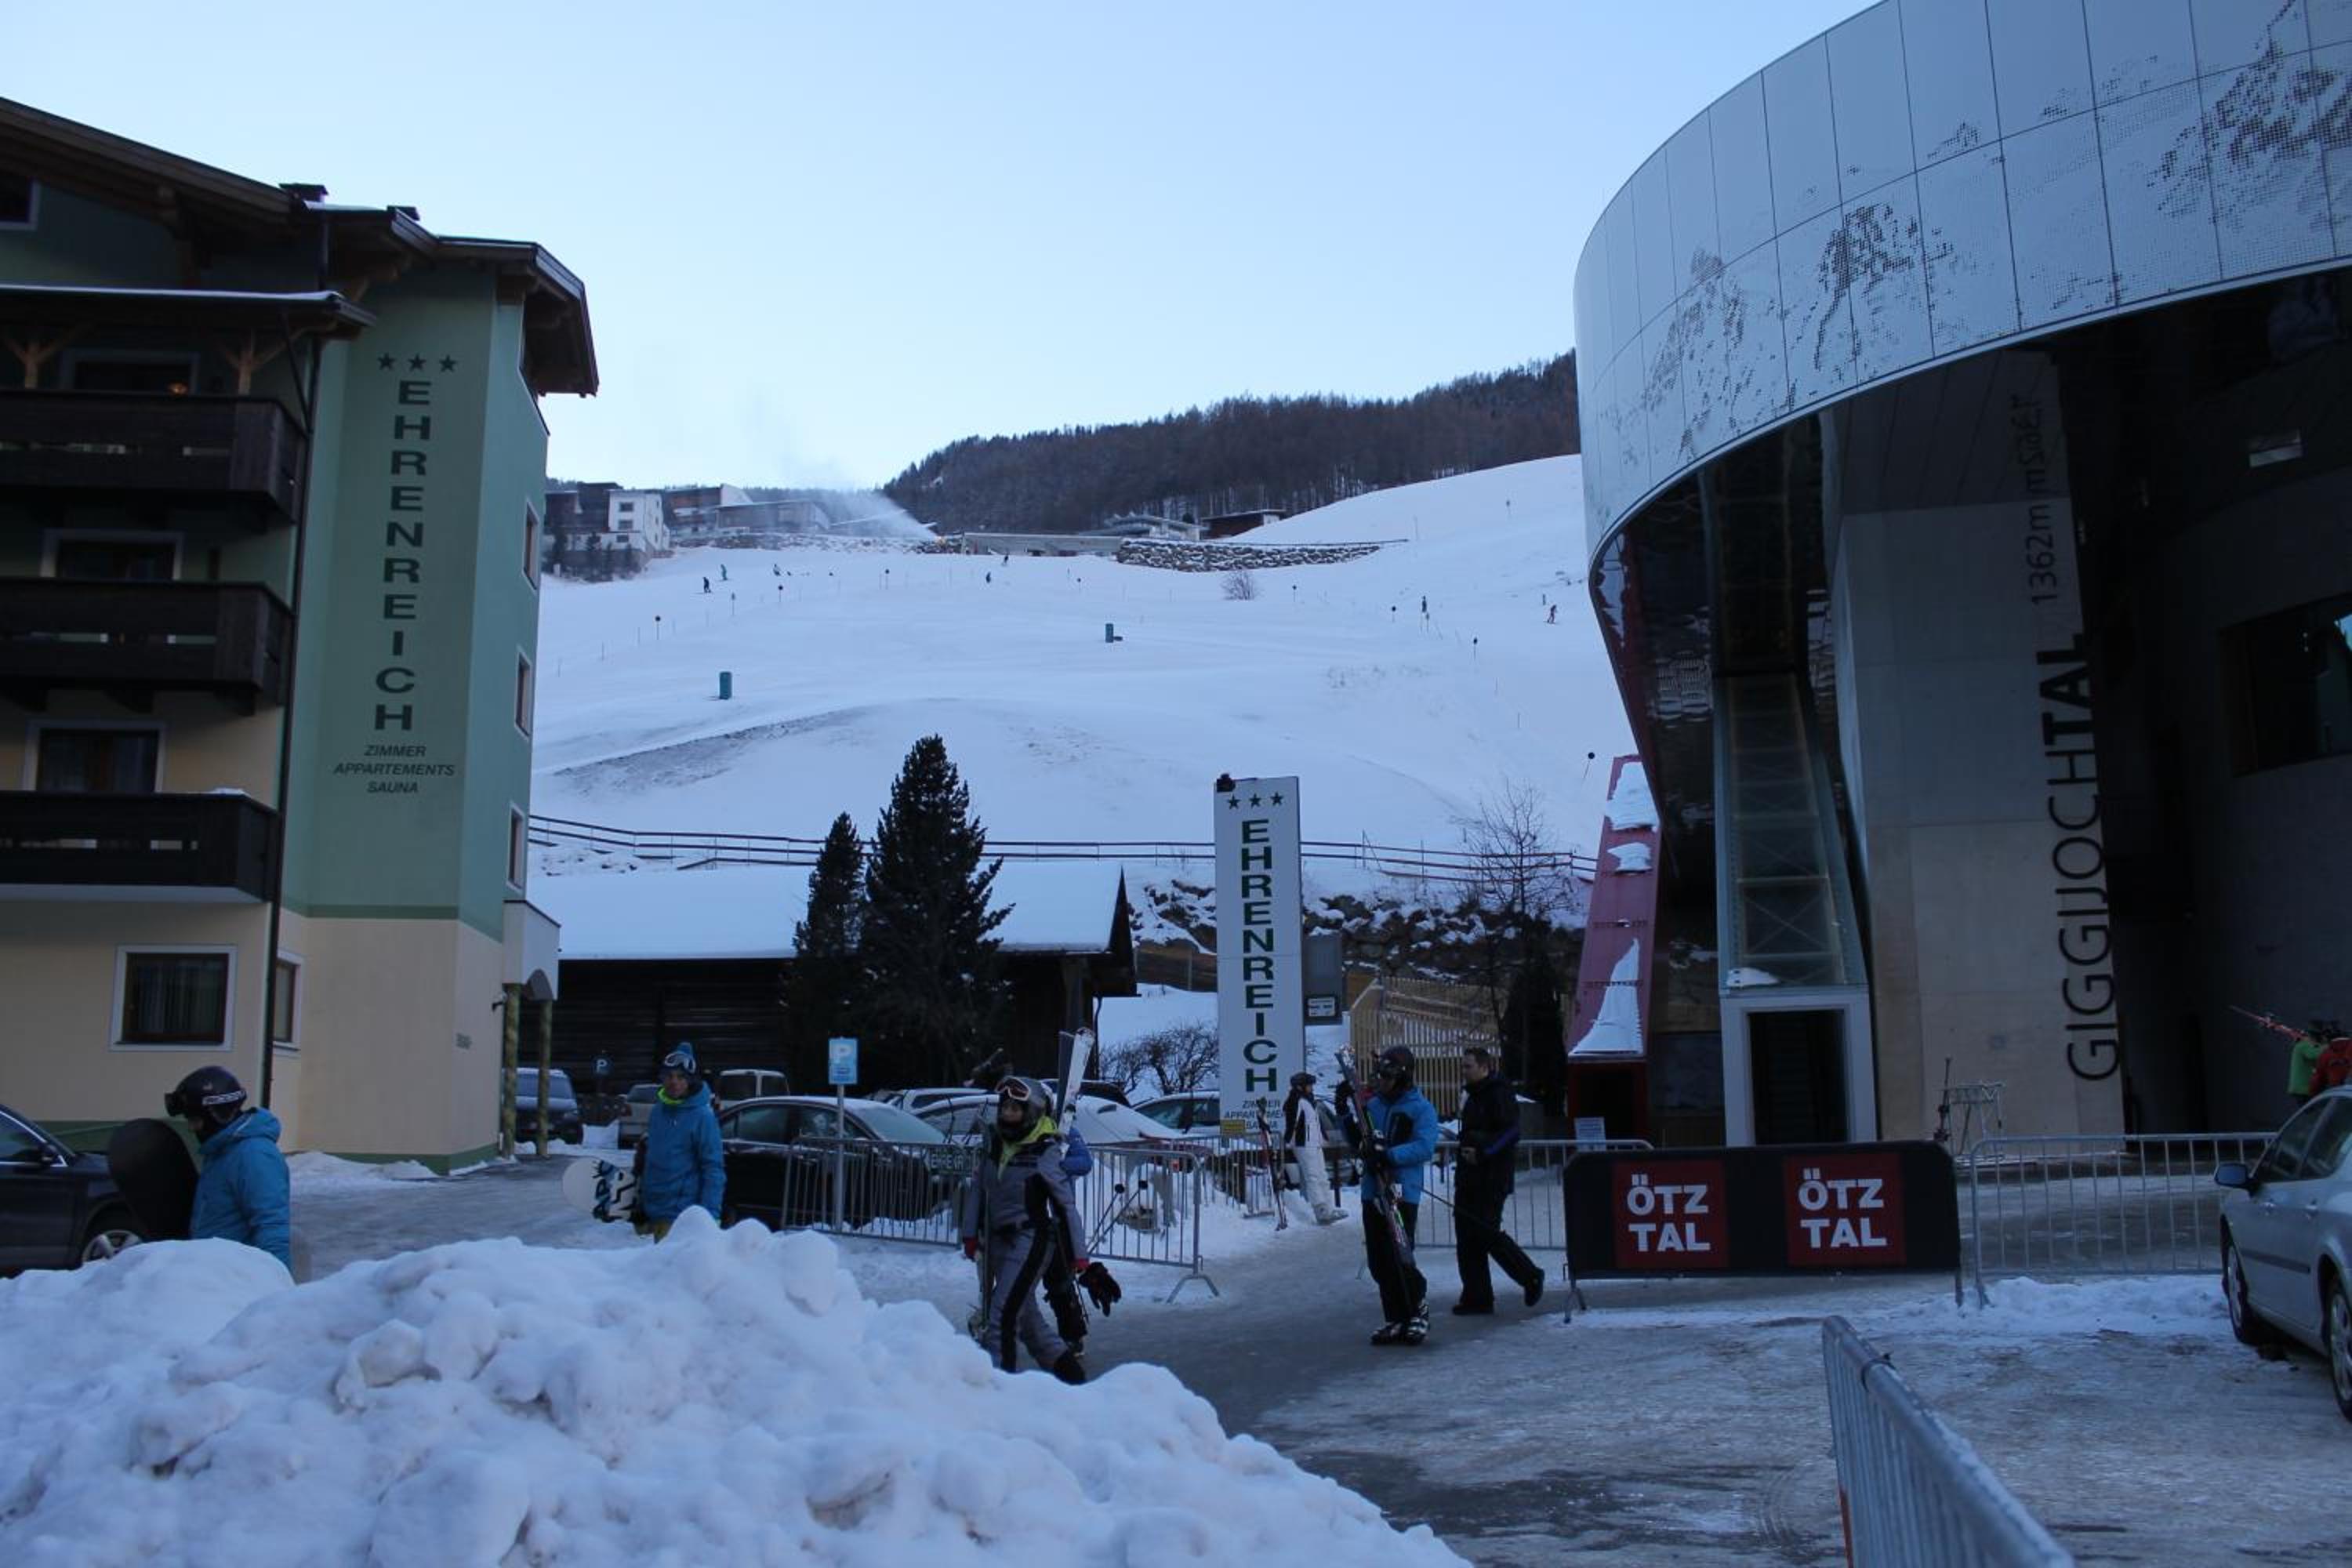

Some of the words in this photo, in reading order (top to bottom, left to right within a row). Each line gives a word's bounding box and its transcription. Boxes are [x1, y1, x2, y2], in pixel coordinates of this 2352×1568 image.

[374, 380, 432, 731] EHRENREICH
[2025, 504, 2057, 604] 1362m
[364, 745, 426, 757] ZIMMER
[333, 763, 456, 776] APPARTEMENTS
[367, 781, 419, 793] SAUNA
[2037, 633, 2119, 1082] GIGGIJOCHTAL
[1241, 819, 1277, 1092] EHRENREICH
[596, 1058, 608, 1073] P
[1627, 1174, 1708, 1215] ÖTZ
[1799, 1167, 1884, 1210] ÖTZ
[1628, 1222, 1711, 1251] TAL
[1801, 1218, 1887, 1249] TAL
